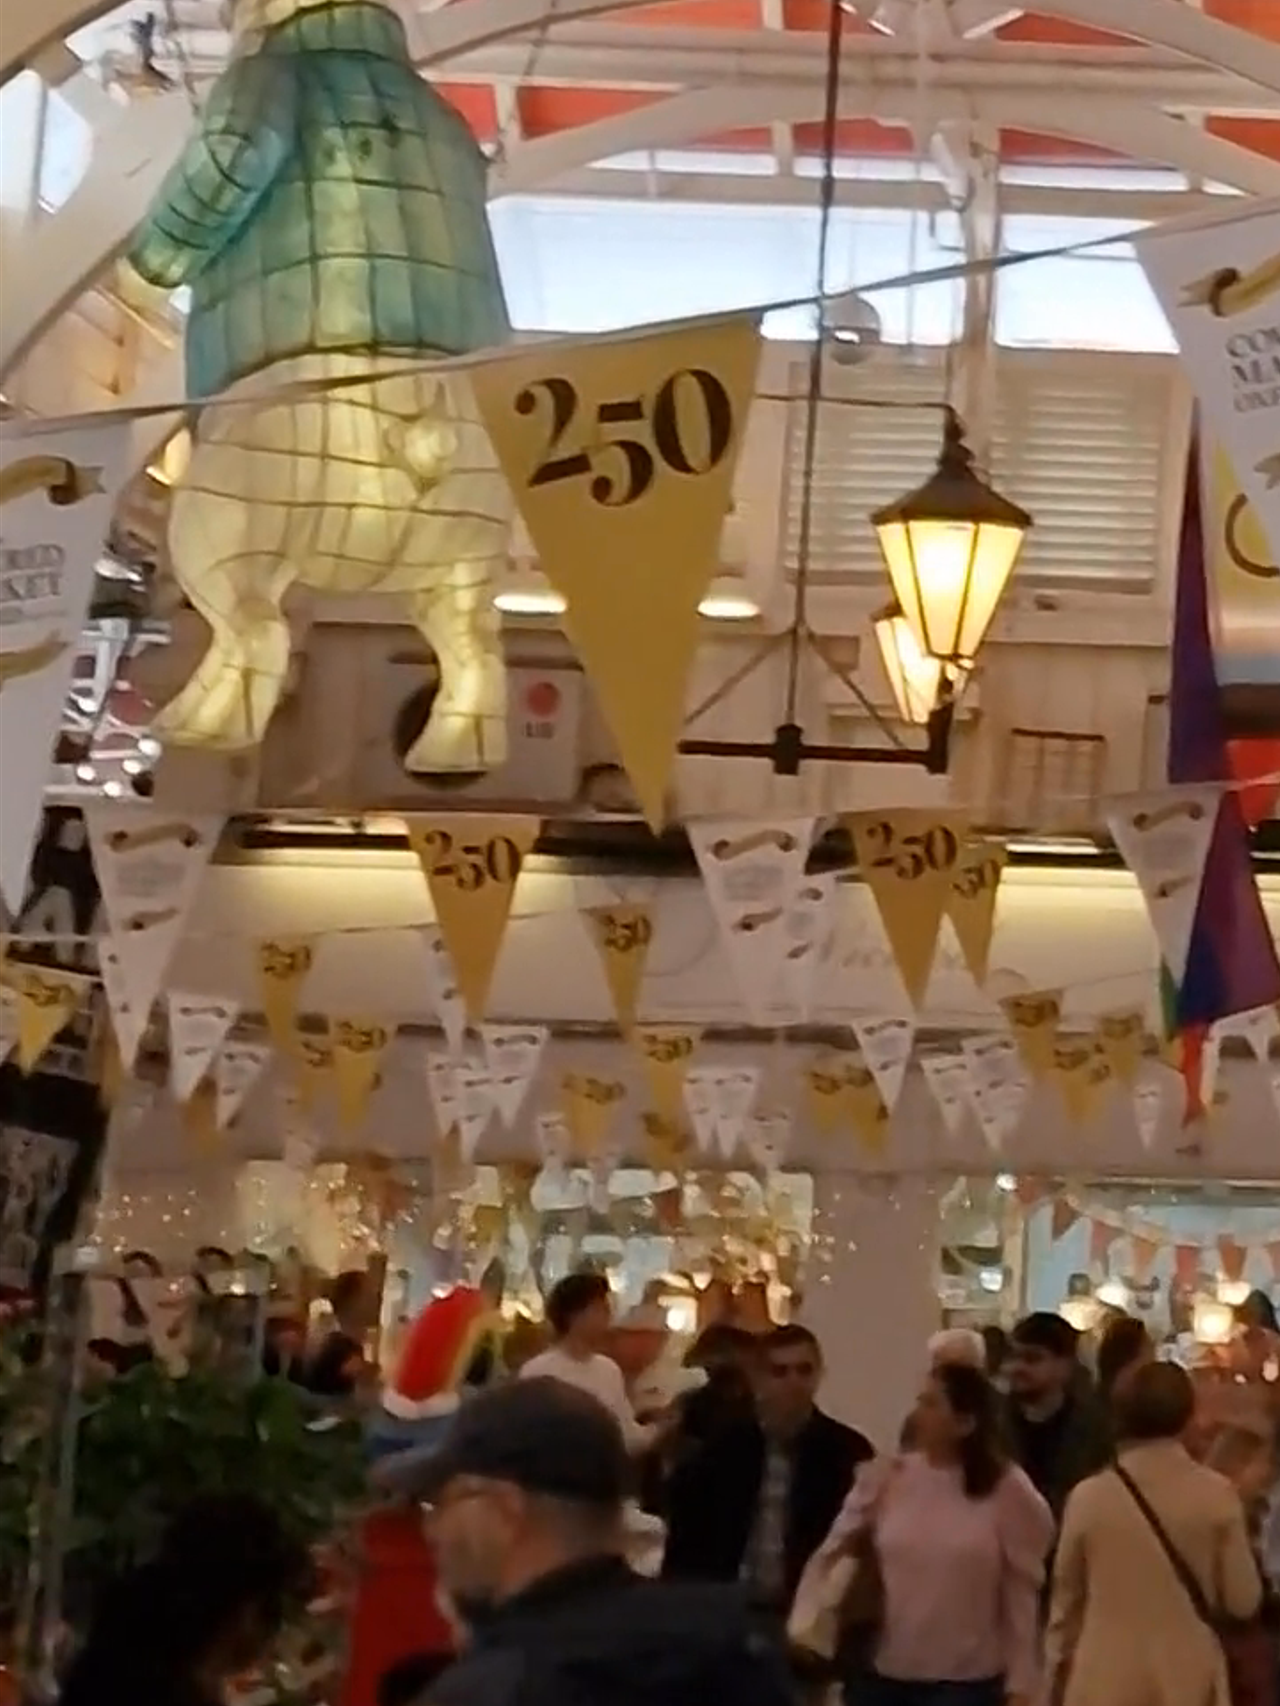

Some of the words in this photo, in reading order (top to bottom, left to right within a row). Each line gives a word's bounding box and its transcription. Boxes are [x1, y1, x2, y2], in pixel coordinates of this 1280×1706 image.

[513, 367, 732, 507] 250
[424, 829, 522, 892] 250
[866, 820, 957, 881] 250
